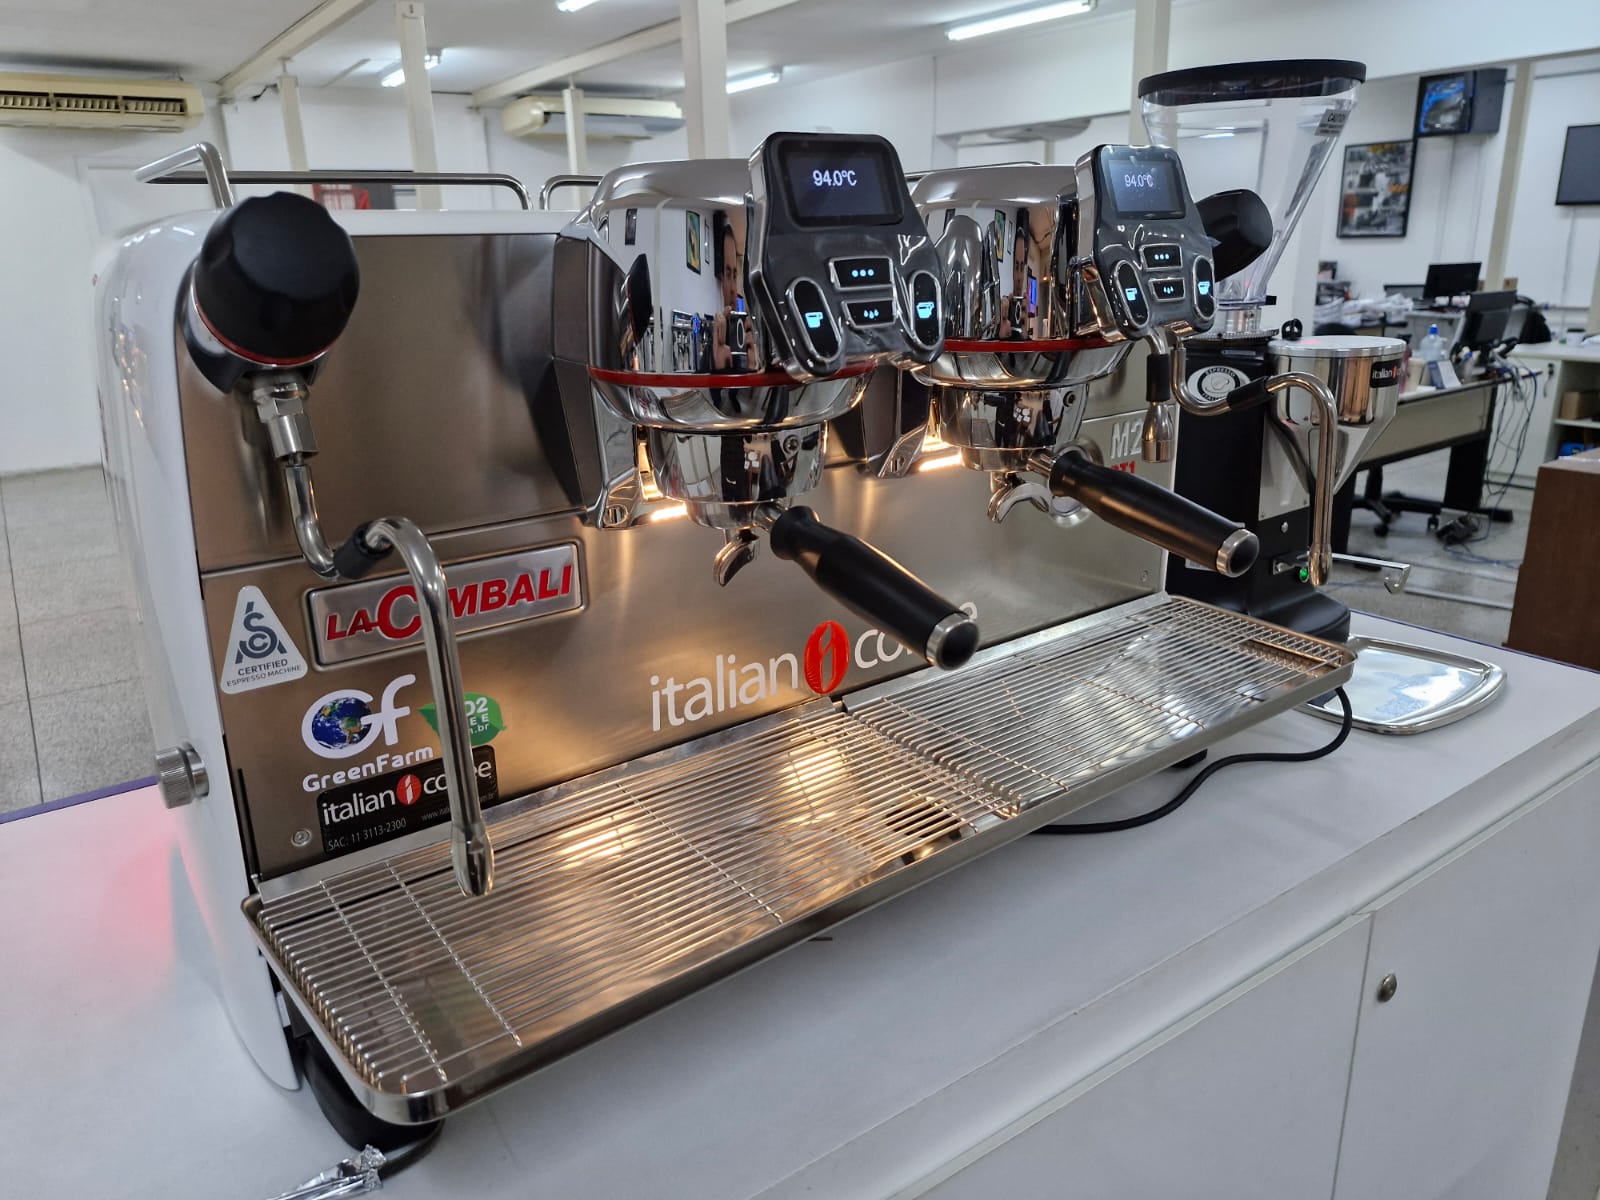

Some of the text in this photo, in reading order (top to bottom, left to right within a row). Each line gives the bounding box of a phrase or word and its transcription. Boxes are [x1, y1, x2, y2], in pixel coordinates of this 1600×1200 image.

[812, 168, 858, 188] 94.0°C
[1123, 172, 1155, 189] 94.0°C
[325, 564, 573, 641] LACMBALI
[226, 663, 302, 688] ESPRESSO MACHINE
[237, 658, 289, 677] CERTIFIED
[649, 652, 799, 733] italian
[463, 696, 489, 717] O2
[302, 745, 434, 793] GreenFarm
[321, 788, 396, 826] italian
[423, 759, 493, 795] coe
[351, 830, 362, 846] 11
[362, 816, 407, 843] 3113-2300
